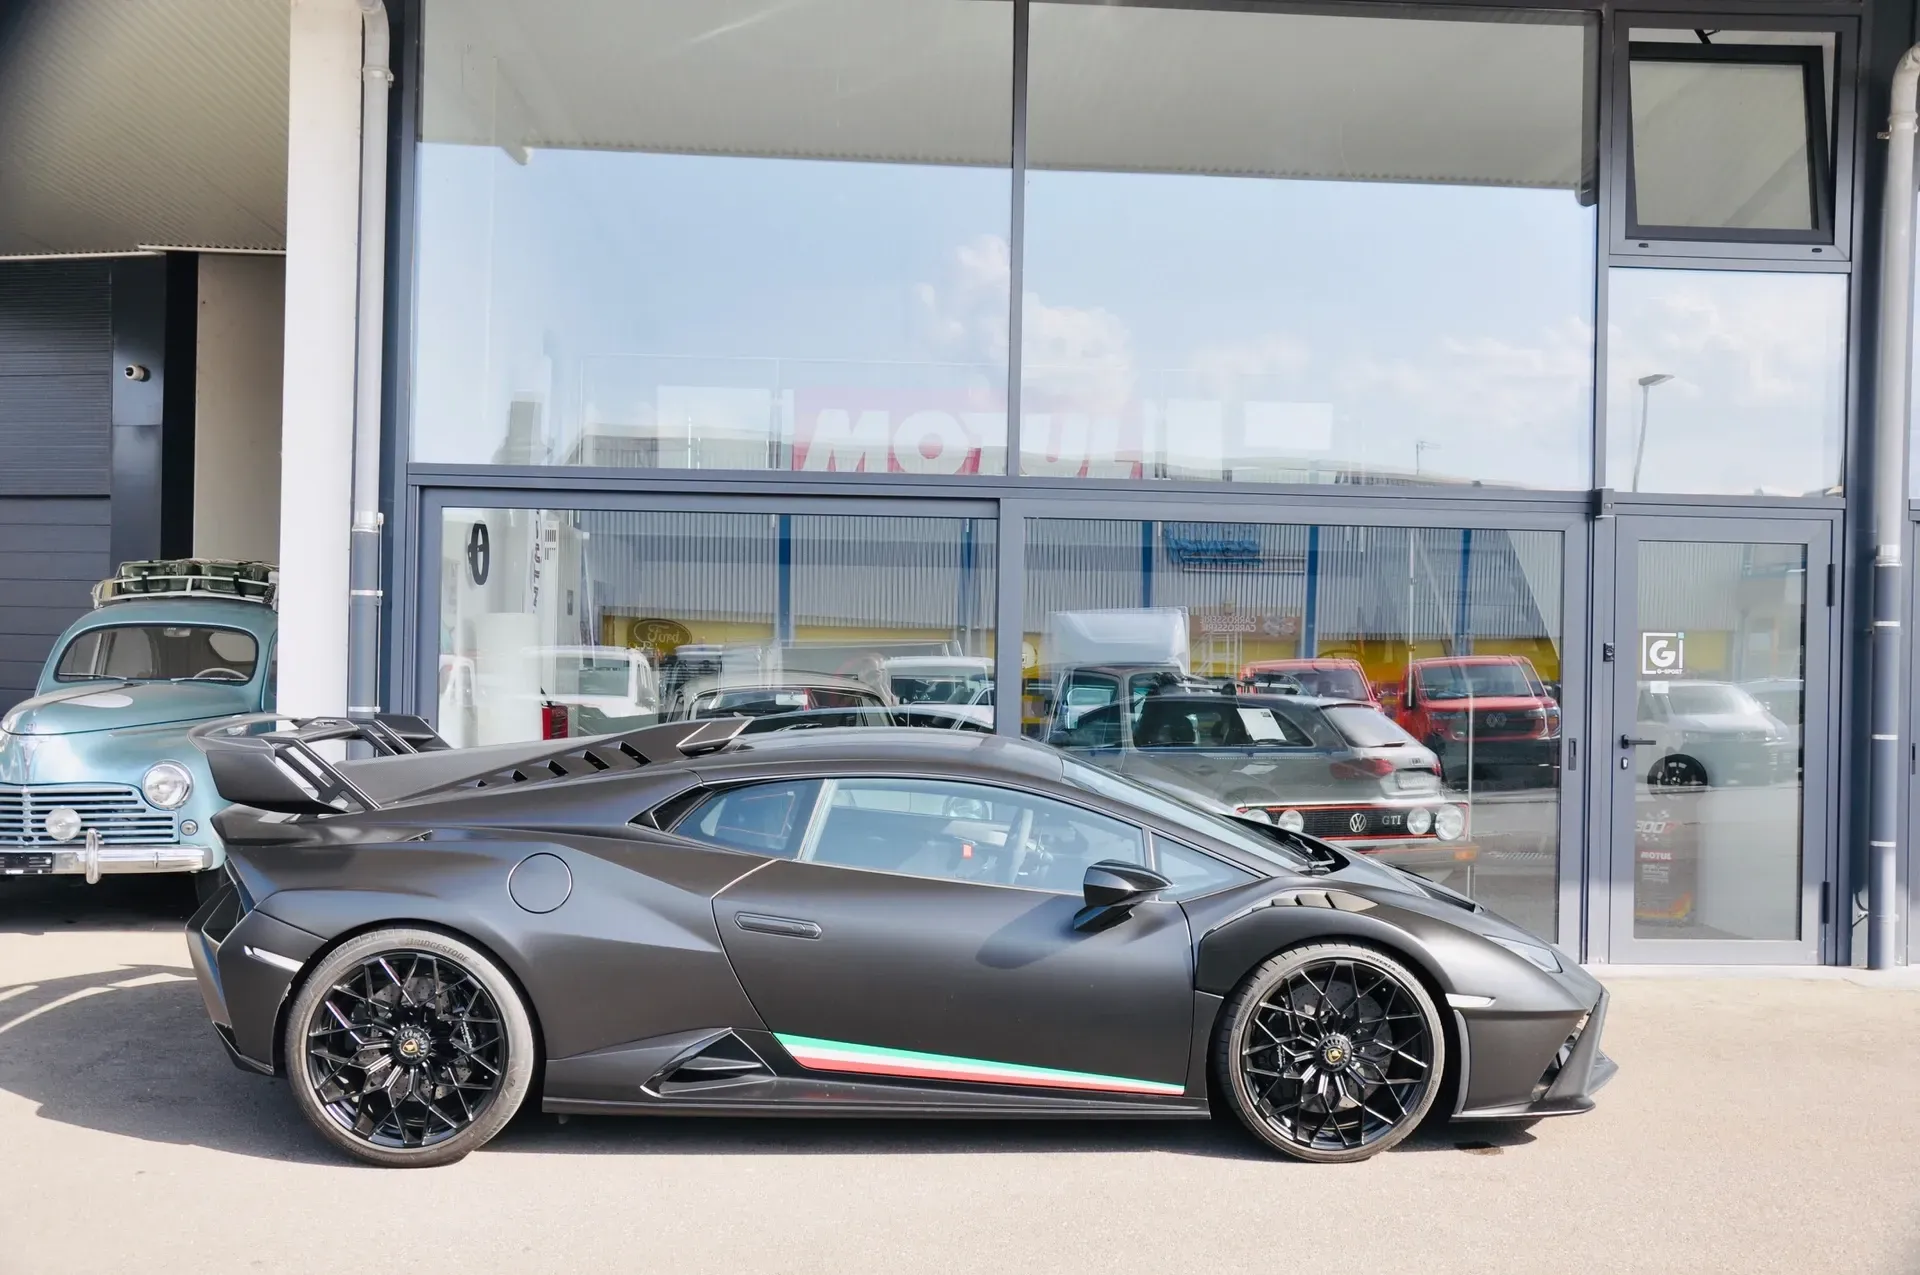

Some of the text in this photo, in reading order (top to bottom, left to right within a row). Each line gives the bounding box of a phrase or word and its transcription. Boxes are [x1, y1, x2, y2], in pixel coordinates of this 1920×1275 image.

[803, 408, 1139, 478] MOTUL
[647, 623, 681, 644] Ford
[1382, 815, 1402, 825] GTI
[1640, 851, 1672, 860] MOTUL
[405, 938, 470, 963] BRIDGESTONE
[1366, 955, 1397, 972] POTENZA
